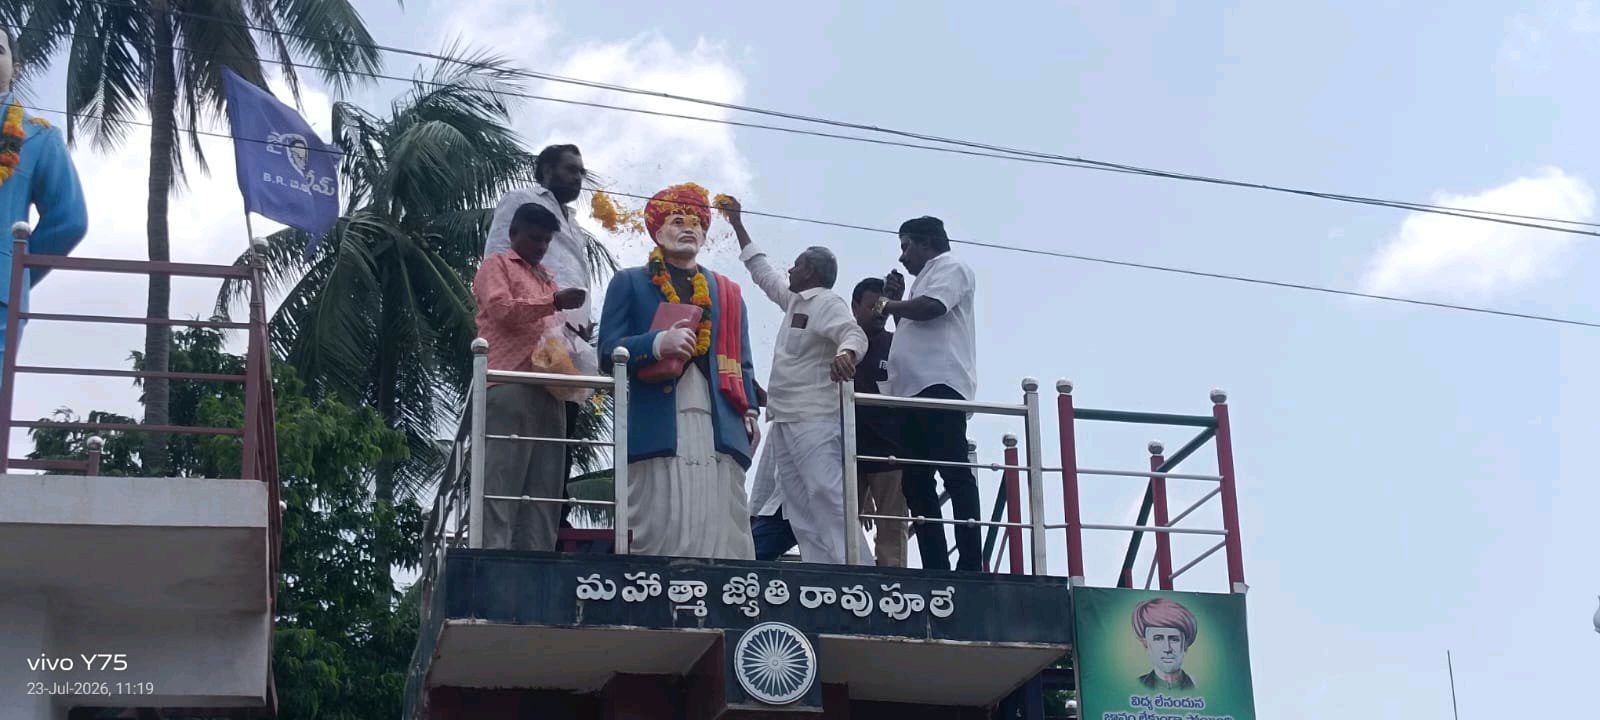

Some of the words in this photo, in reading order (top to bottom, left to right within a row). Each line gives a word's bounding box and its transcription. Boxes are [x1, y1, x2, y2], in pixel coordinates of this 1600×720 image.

[576, 571, 708, 617] మహాత్మా
[1131, 695, 1153, 711] విద్య
[1154, 694, 1205, 709] లేనందున
